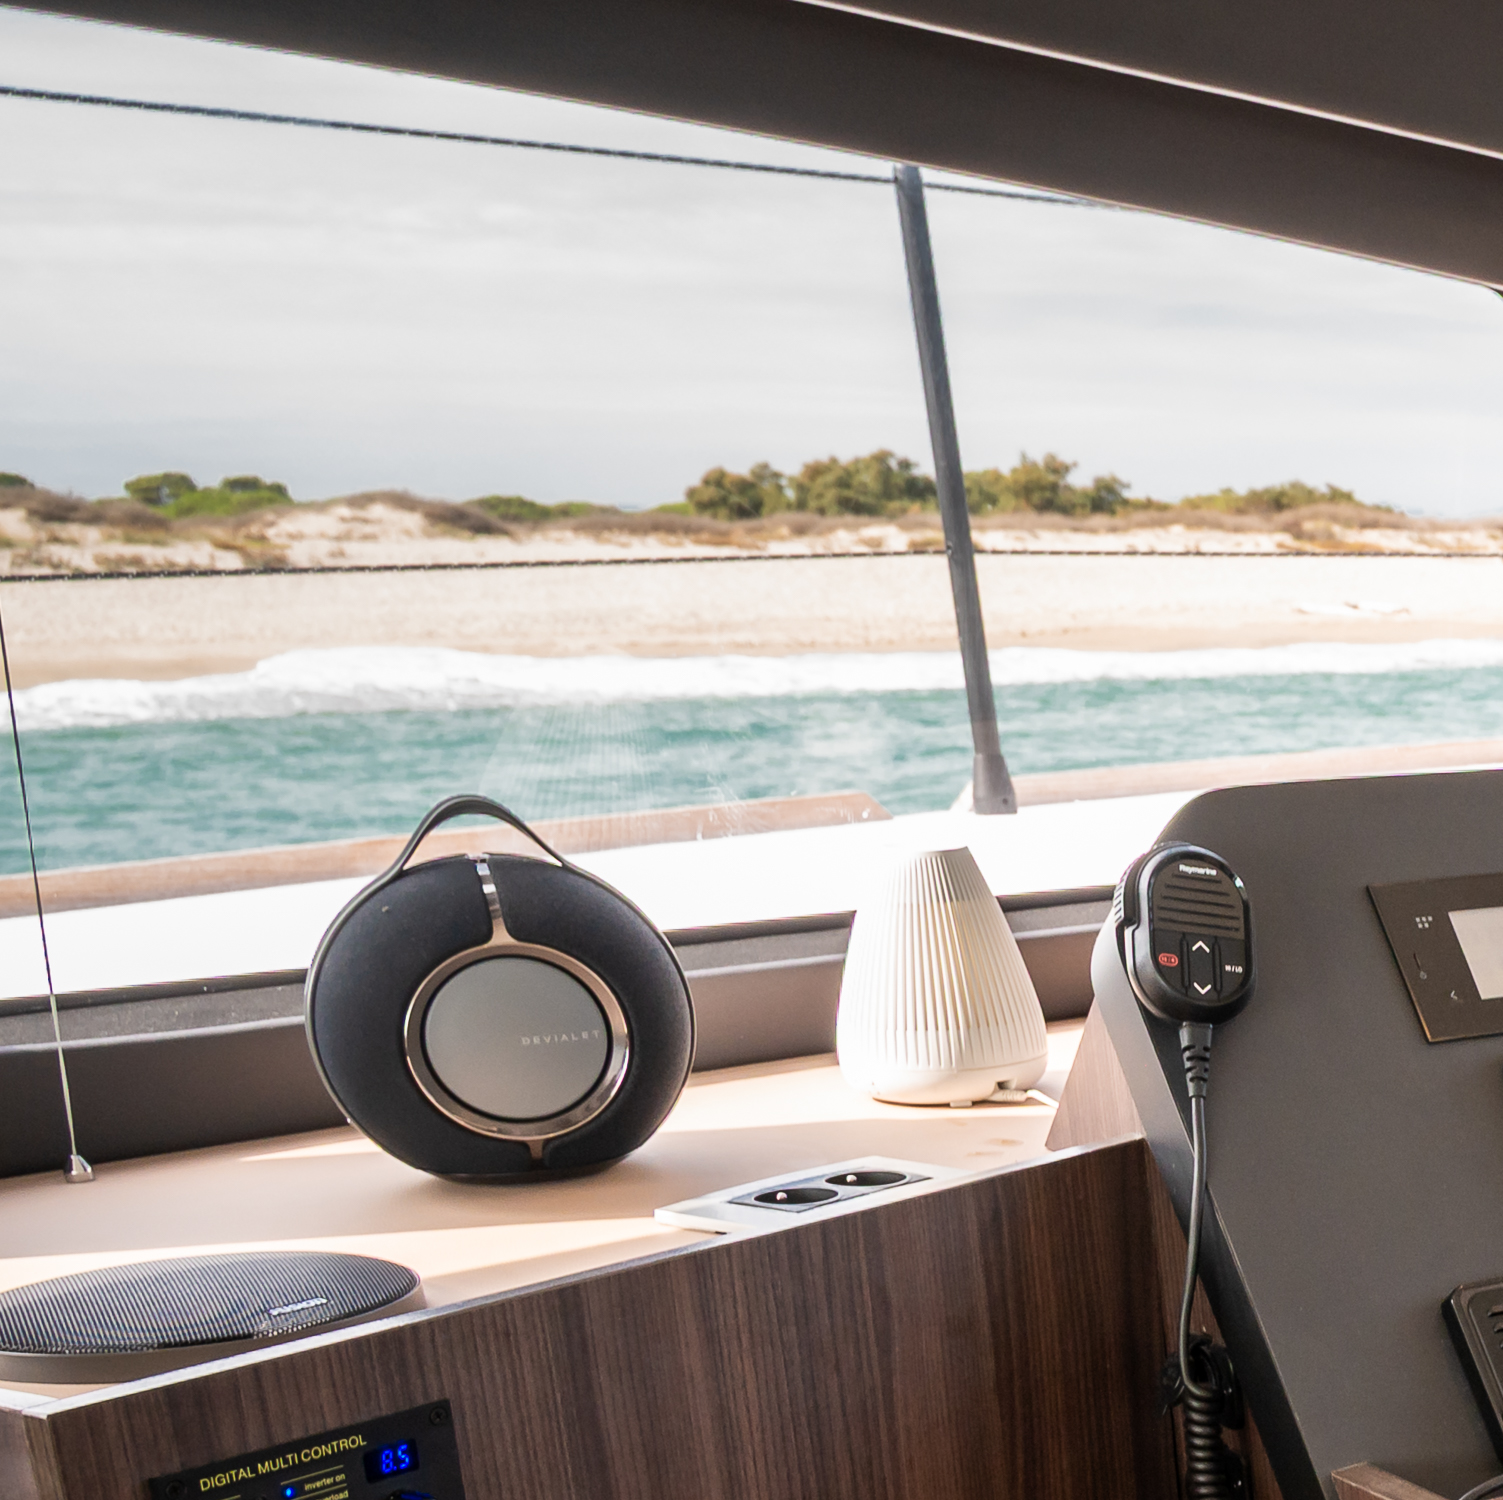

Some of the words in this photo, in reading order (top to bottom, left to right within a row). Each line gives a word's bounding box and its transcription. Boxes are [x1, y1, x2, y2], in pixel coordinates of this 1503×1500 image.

[1179, 864, 1217, 876] Raymarine
[521, 1029, 600, 1045] DEVIALET
[199, 1466, 255, 1491] DIGITAL
[257, 1452, 299, 1475] MULTI
[300, 1434, 367, 1463] CONTROL
[381, 1443, 410, 1474] 8.5
[304, 1476, 334, 1491] inverter
[335, 1473, 346, 1482] on
